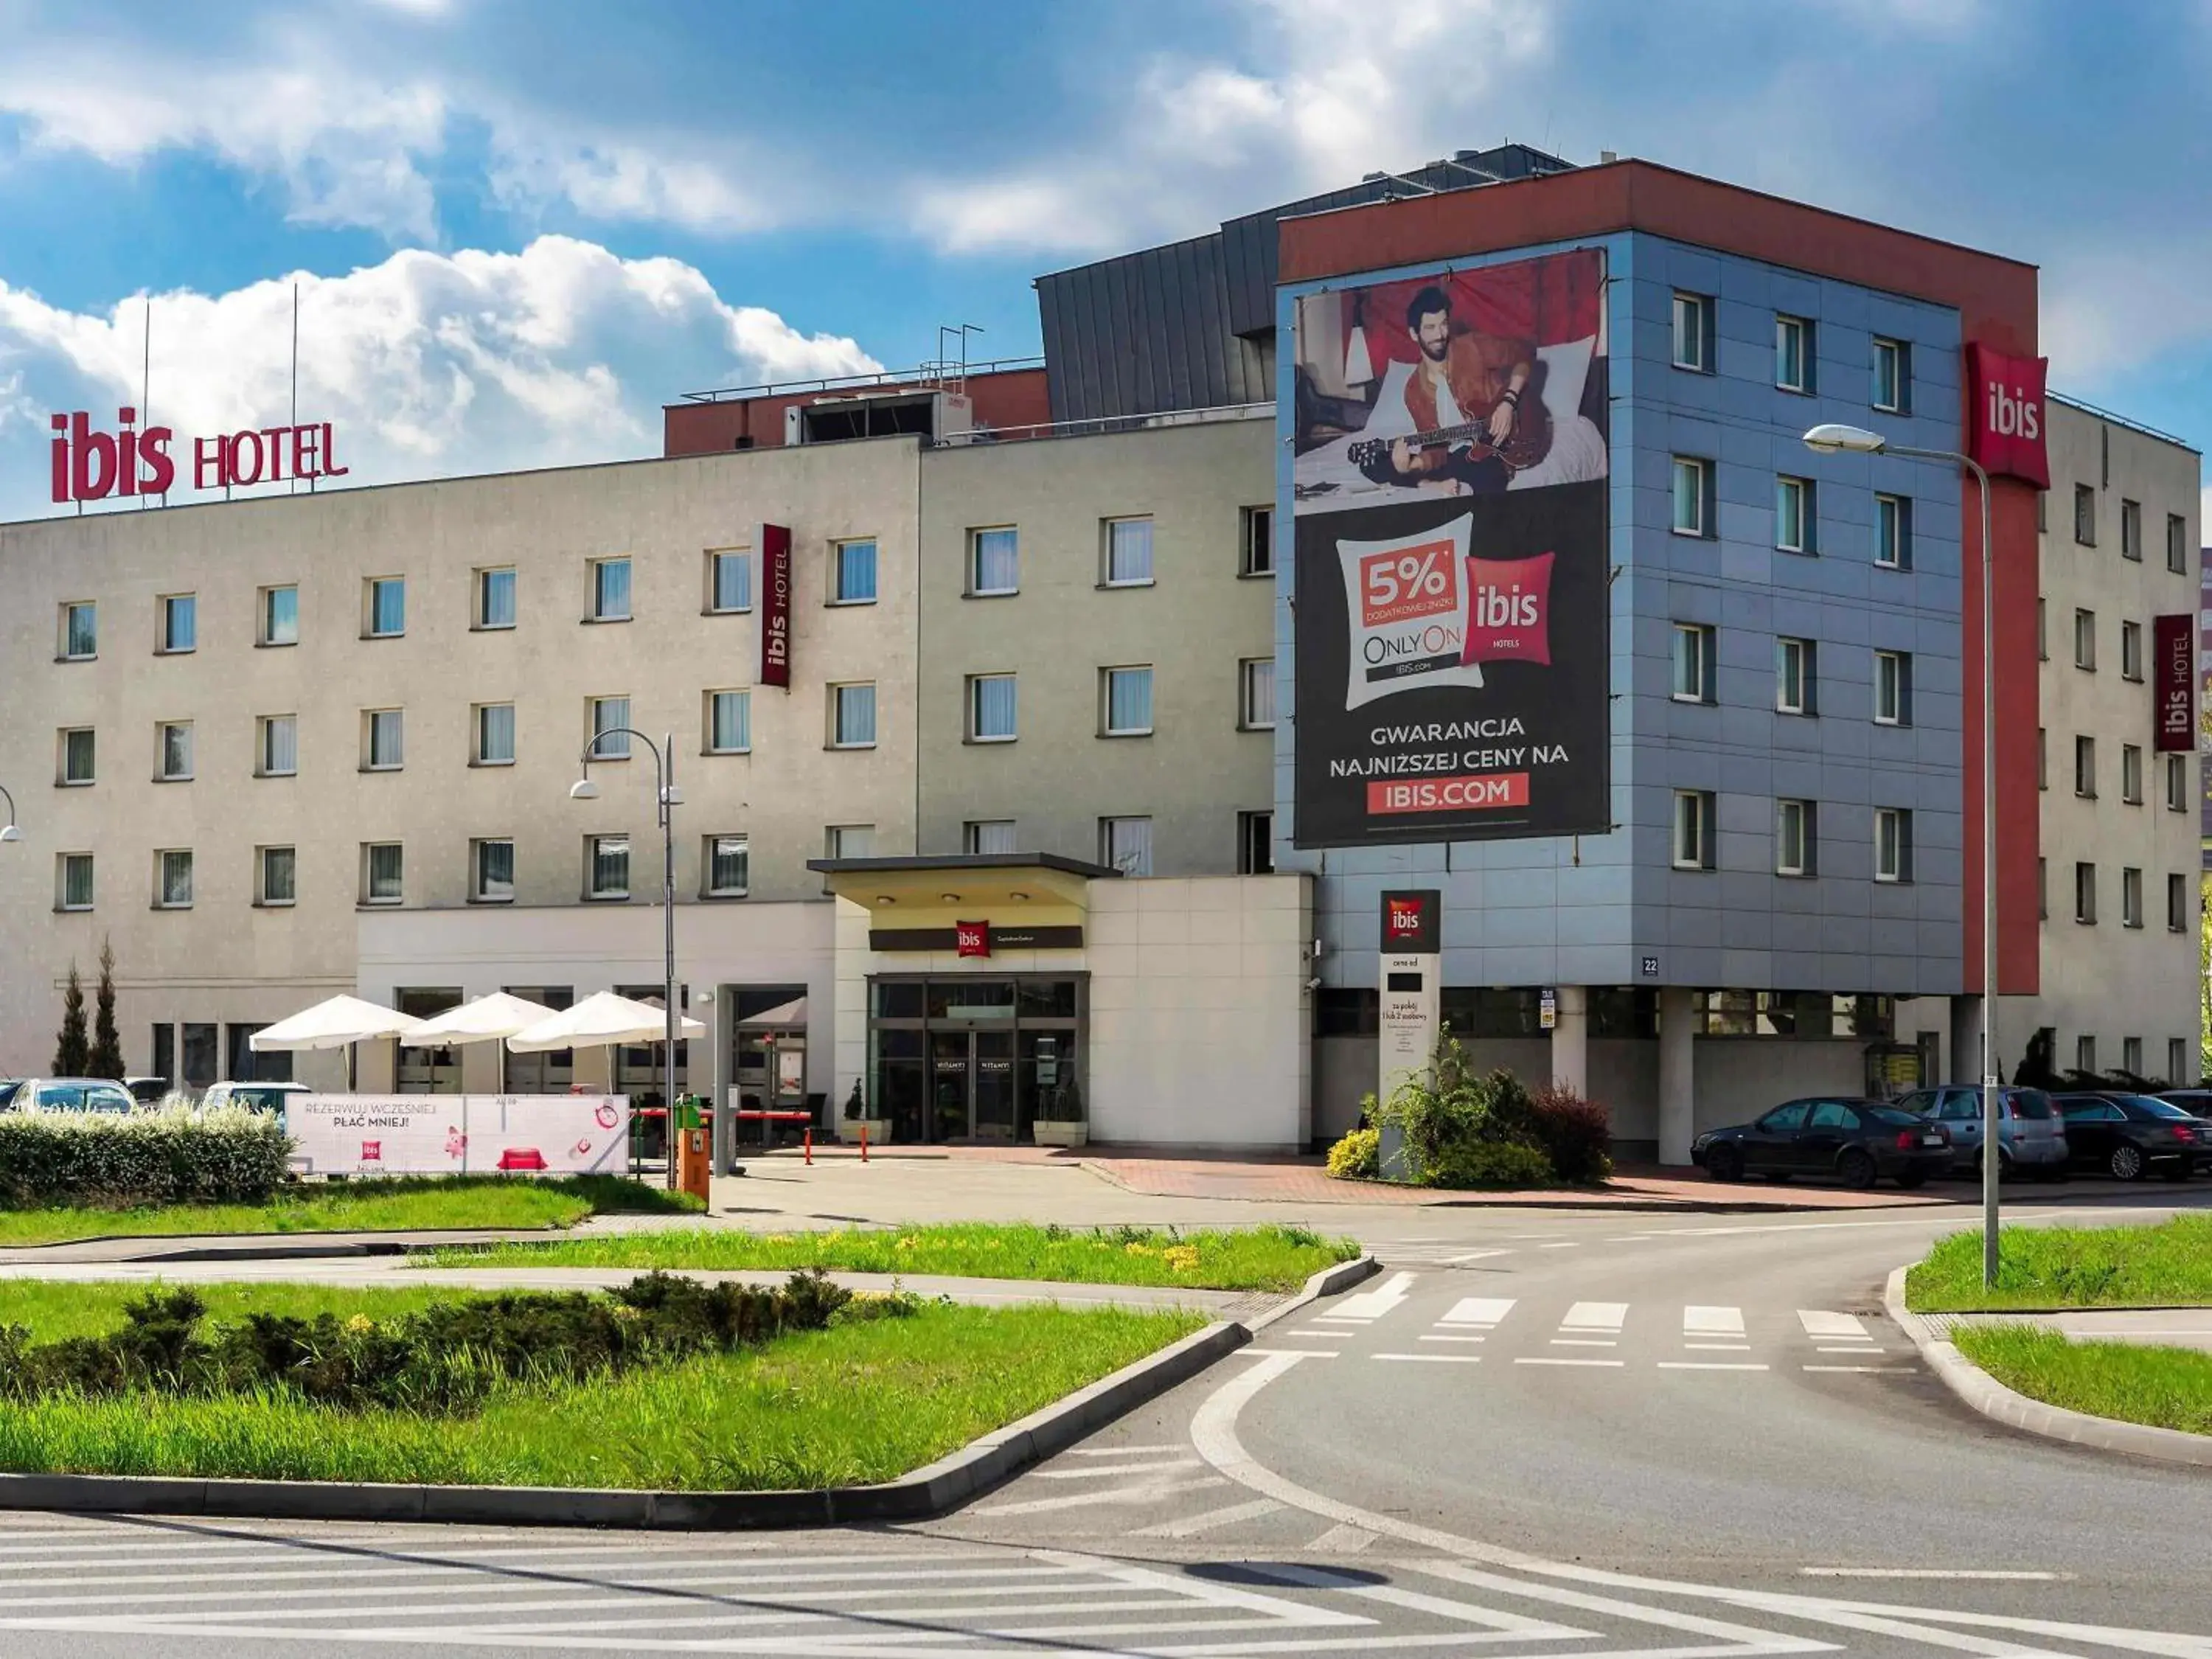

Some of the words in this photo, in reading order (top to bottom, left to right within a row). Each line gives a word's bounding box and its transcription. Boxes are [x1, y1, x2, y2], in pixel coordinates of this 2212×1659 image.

[1989, 381, 2039, 439] ibis
[52, 407, 175, 503] ibis
[194, 422, 348, 490] HOTEL
[775, 548, 787, 607] HOTEL
[1477, 584, 1538, 627] ibis
[768, 616, 785, 666] ibis
[1493, 639, 1520, 648] HOTELS
[2174, 633, 2188, 682] HOTEL
[2165, 691, 2188, 733] ibis
[1370, 717, 1526, 745] GWARANCJA
[1330, 752, 1458, 777] NAJNIŻSZEJ
[1463, 748, 1526, 769] CENY
[1532, 744, 1569, 764] NA
[1385, 779, 1509, 808] IBIS.COM
[1393, 911, 1419, 928] ibis
[959, 931, 980, 946] ibis
[1645, 960, 1657, 971] 22
[305, 1103, 367, 1114] REZERWUJ
[371, 1102, 437, 1114] WCZEŚNIEJ
[333, 1114, 365, 1127] PŁAĆ
[369, 1117, 410, 1127] MNIEJ!
